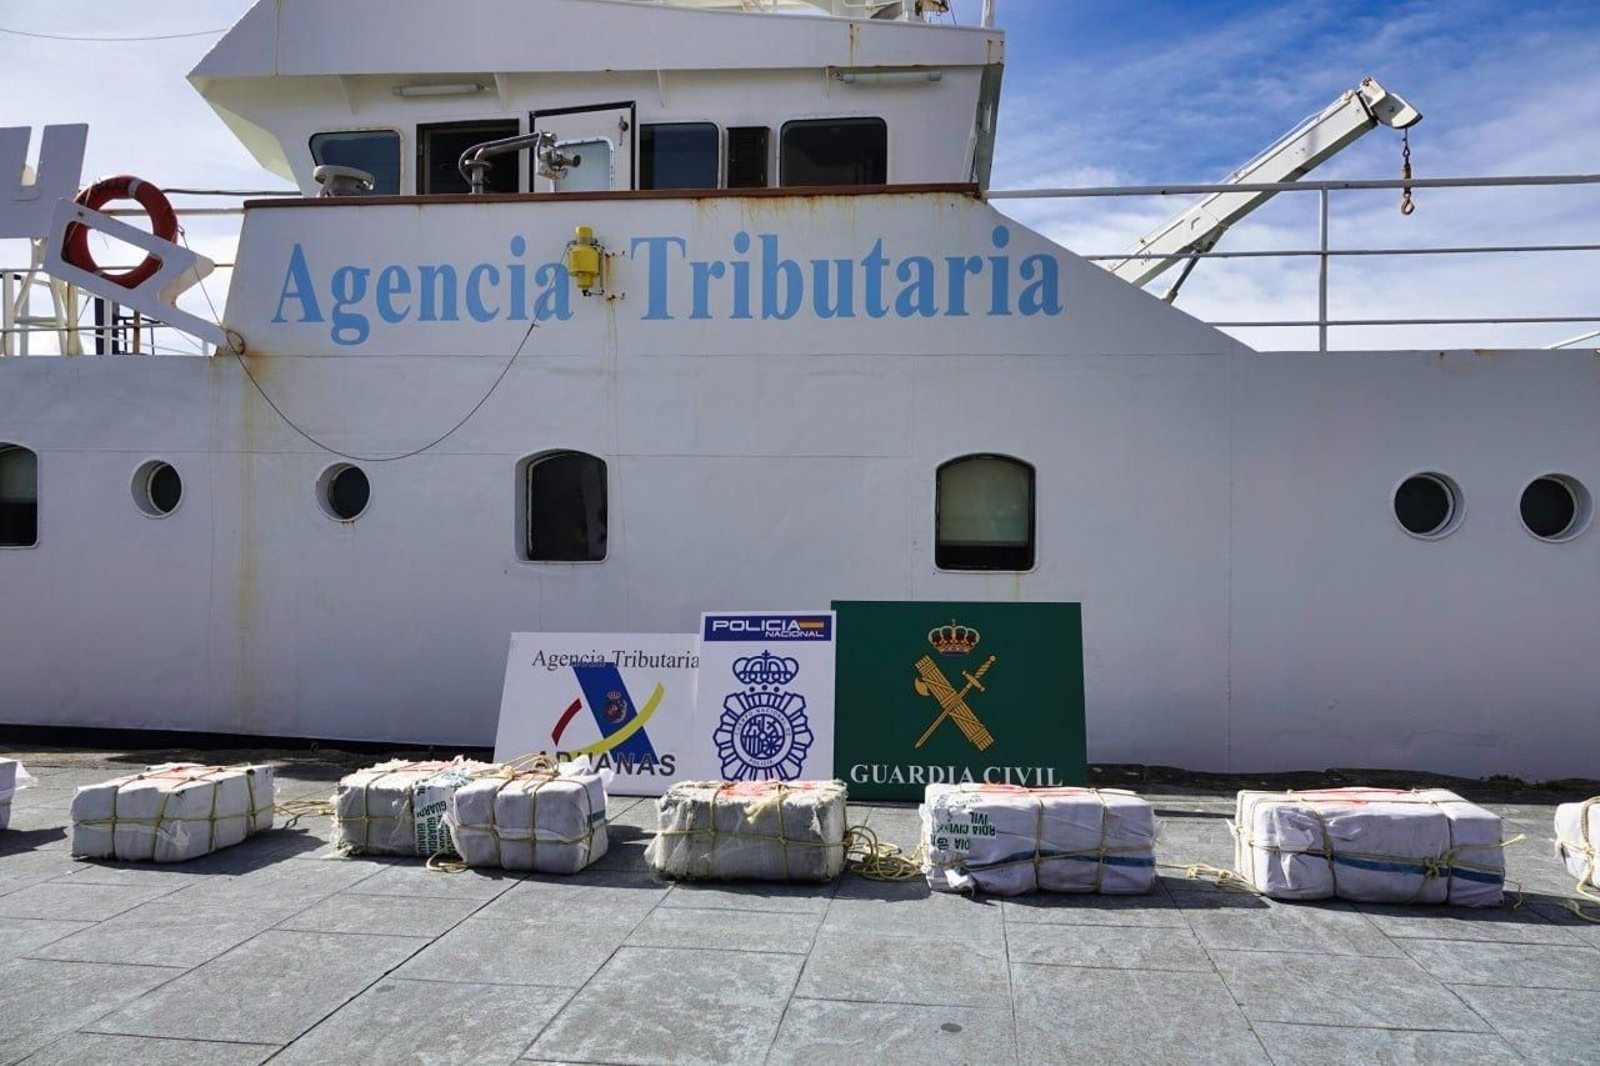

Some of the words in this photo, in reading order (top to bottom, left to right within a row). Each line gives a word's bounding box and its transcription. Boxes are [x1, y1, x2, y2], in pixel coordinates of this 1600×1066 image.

[271, 235, 574, 346] Agencia
[631, 226, 1064, 320] Tributaria
[712, 620, 801, 632] POLICIA
[765, 630, 824, 638] NACIONAL
[532, 650, 605, 671] Agencia
[612, 650, 700, 669] Tributaria
[850, 764, 974, 784] GUARDIA
[983, 766, 1063, 786] CIVIL
